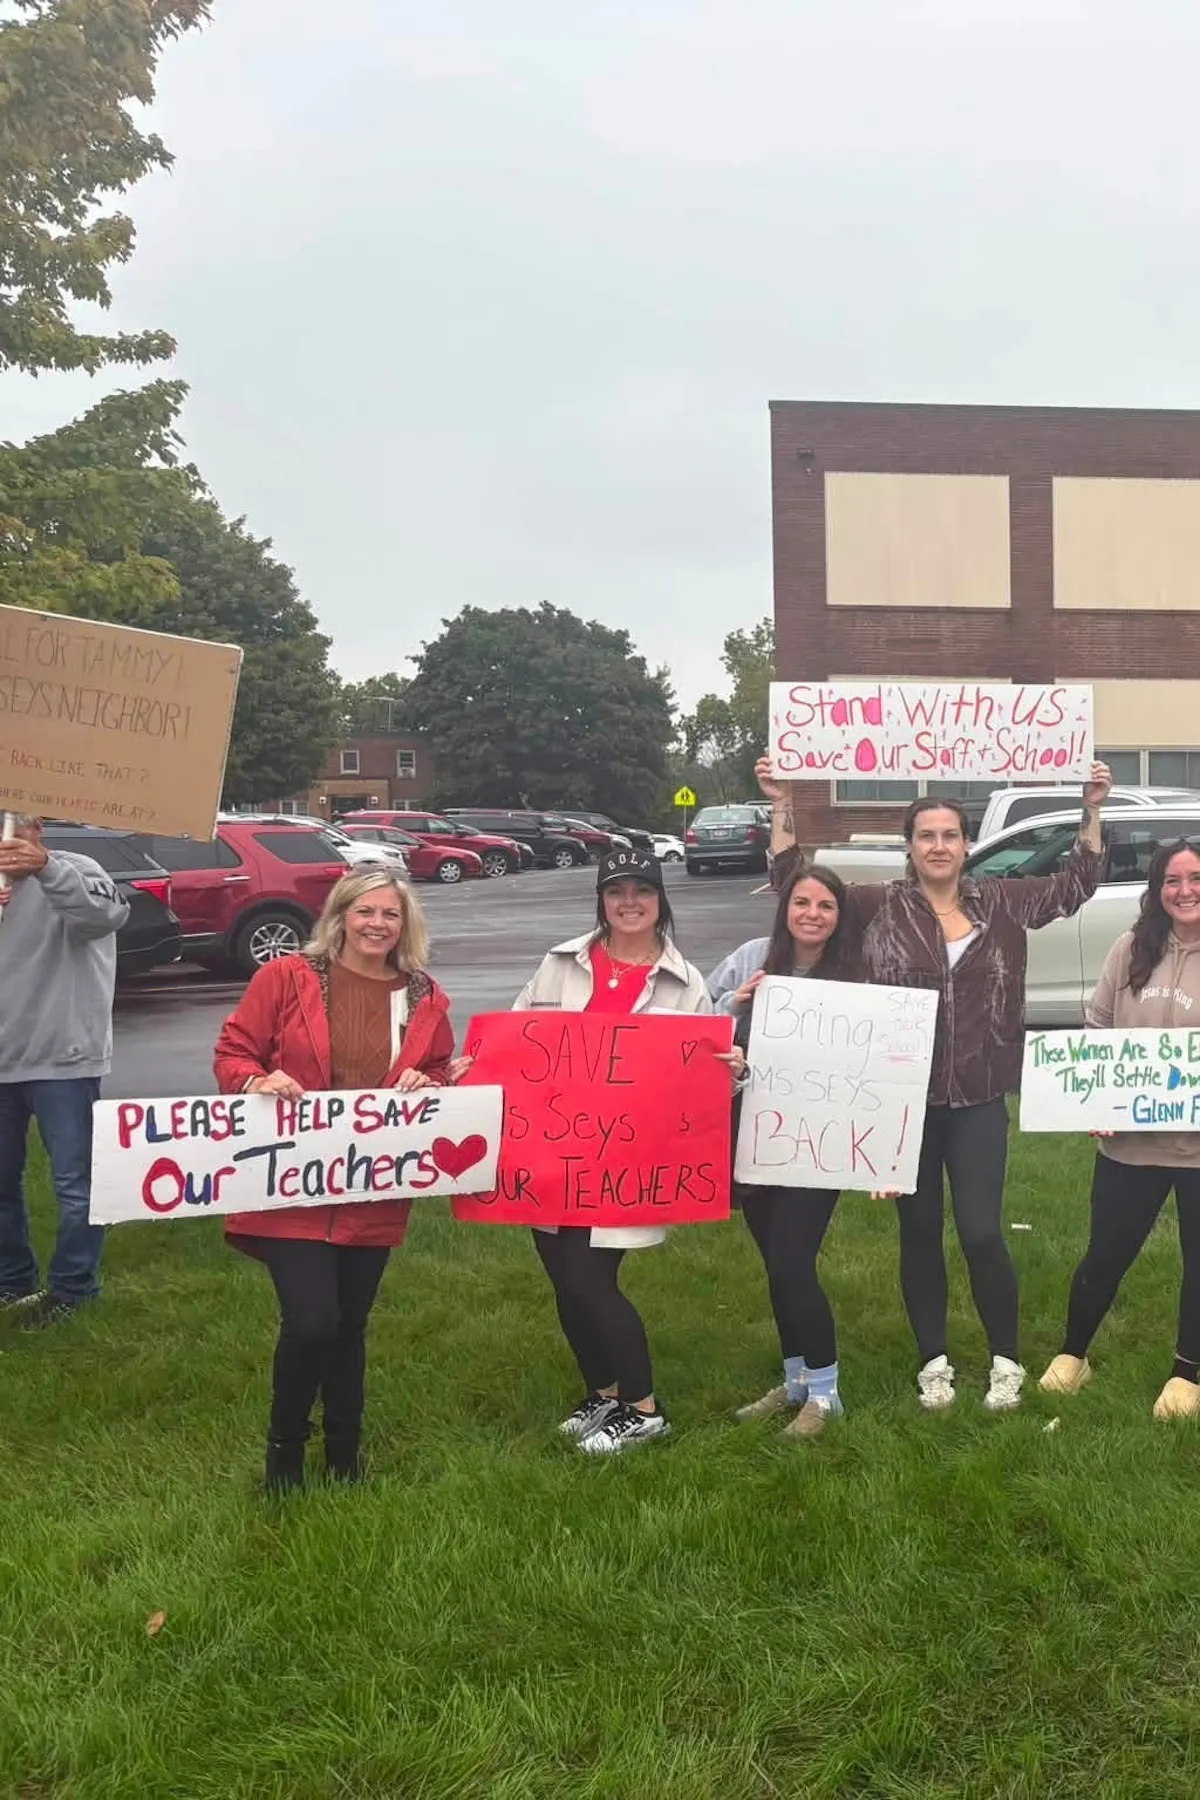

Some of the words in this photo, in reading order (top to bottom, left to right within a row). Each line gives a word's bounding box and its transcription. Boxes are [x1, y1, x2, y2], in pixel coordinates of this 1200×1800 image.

[25, 627, 72, 666] FOR
[75, 636, 186, 686] TAMMY!
[57, 683, 191, 740] NEIGHBOR!
[785, 684, 884, 728] Stand
[898, 685, 993, 731] With
[777, 730, 849, 771] Save
[854, 737, 909, 772] Our
[911, 730, 975, 771] Staff
[990, 726, 1087, 773] School!
[607, 852, 651, 871] GOLF
[520, 1019, 640, 1084] SAVE
[762, 985, 874, 1077] Bring
[1028, 1034, 1067, 1067] These
[1066, 1033, 1114, 1063] Women
[1118, 1037, 1148, 1061] Are
[1158, 1031, 1183, 1061] So
[750, 1065, 794, 1097] MS
[803, 1069, 882, 1112] SEYS
[1112, 1062, 1163, 1089] Settle
[118, 1099, 246, 1149] PLEASE
[276, 1097, 345, 1137] HELP
[353, 1093, 441, 1134] SAVE
[543, 1092, 636, 1161] Seys
[753, 1104, 909, 1177] BACK!
[142, 1157, 237, 1212] Our
[233, 1141, 441, 1198] Teachers
[558, 1155, 717, 1210] TEACHERS
